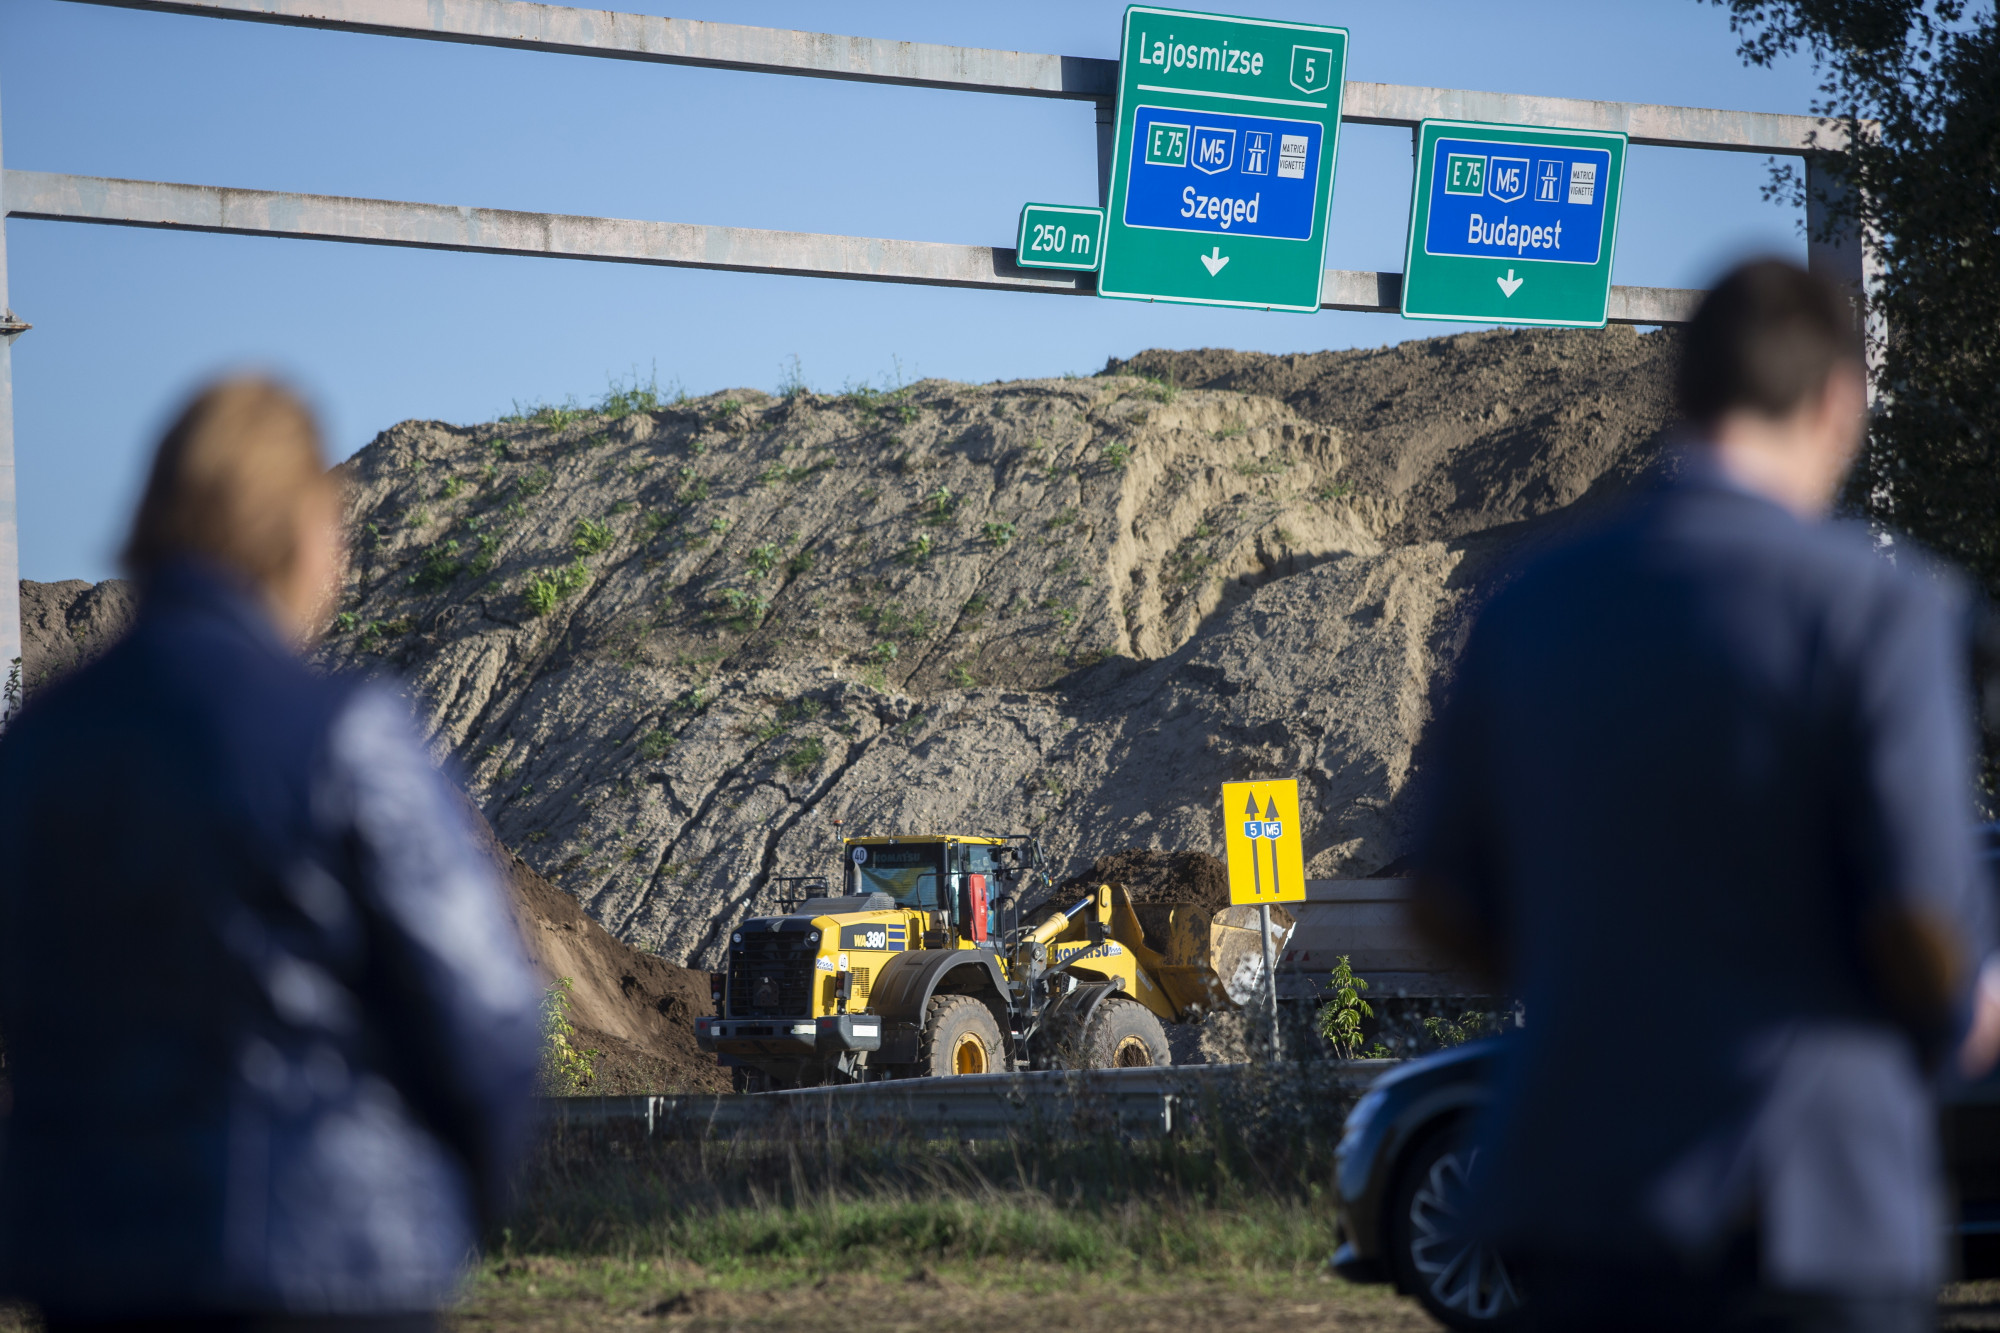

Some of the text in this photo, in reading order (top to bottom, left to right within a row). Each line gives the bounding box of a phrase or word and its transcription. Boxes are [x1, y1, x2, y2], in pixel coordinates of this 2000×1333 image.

[1139, 32, 1264, 76] Lajosmizse
[1305, 58, 1316, 84] 5
[1153, 130, 1184, 158] E 75
[1199, 138, 1226, 165] M5
[1282, 143, 1306, 154] MATRICA
[1279, 160, 1305, 171] VIGNETTE
[1453, 161, 1481, 187] E 75
[1496, 167, 1520, 193] M5
[1572, 170, 1594, 180] MATRICA
[1569, 186, 1594, 197] VIGNETTE
[1180, 186, 1260, 229] Szeged
[1031, 224, 1090, 254] 250 m
[1467, 213, 1562, 255] Budapest
[1250, 823, 1257, 836] 5
[1265, 824, 1280, 836] M5
[854, 849, 865, 861] 40
[874, 852, 921, 863] KOMATSU
[854, 931, 886, 948] WA380
[1054, 944, 1109, 962] KOSU
